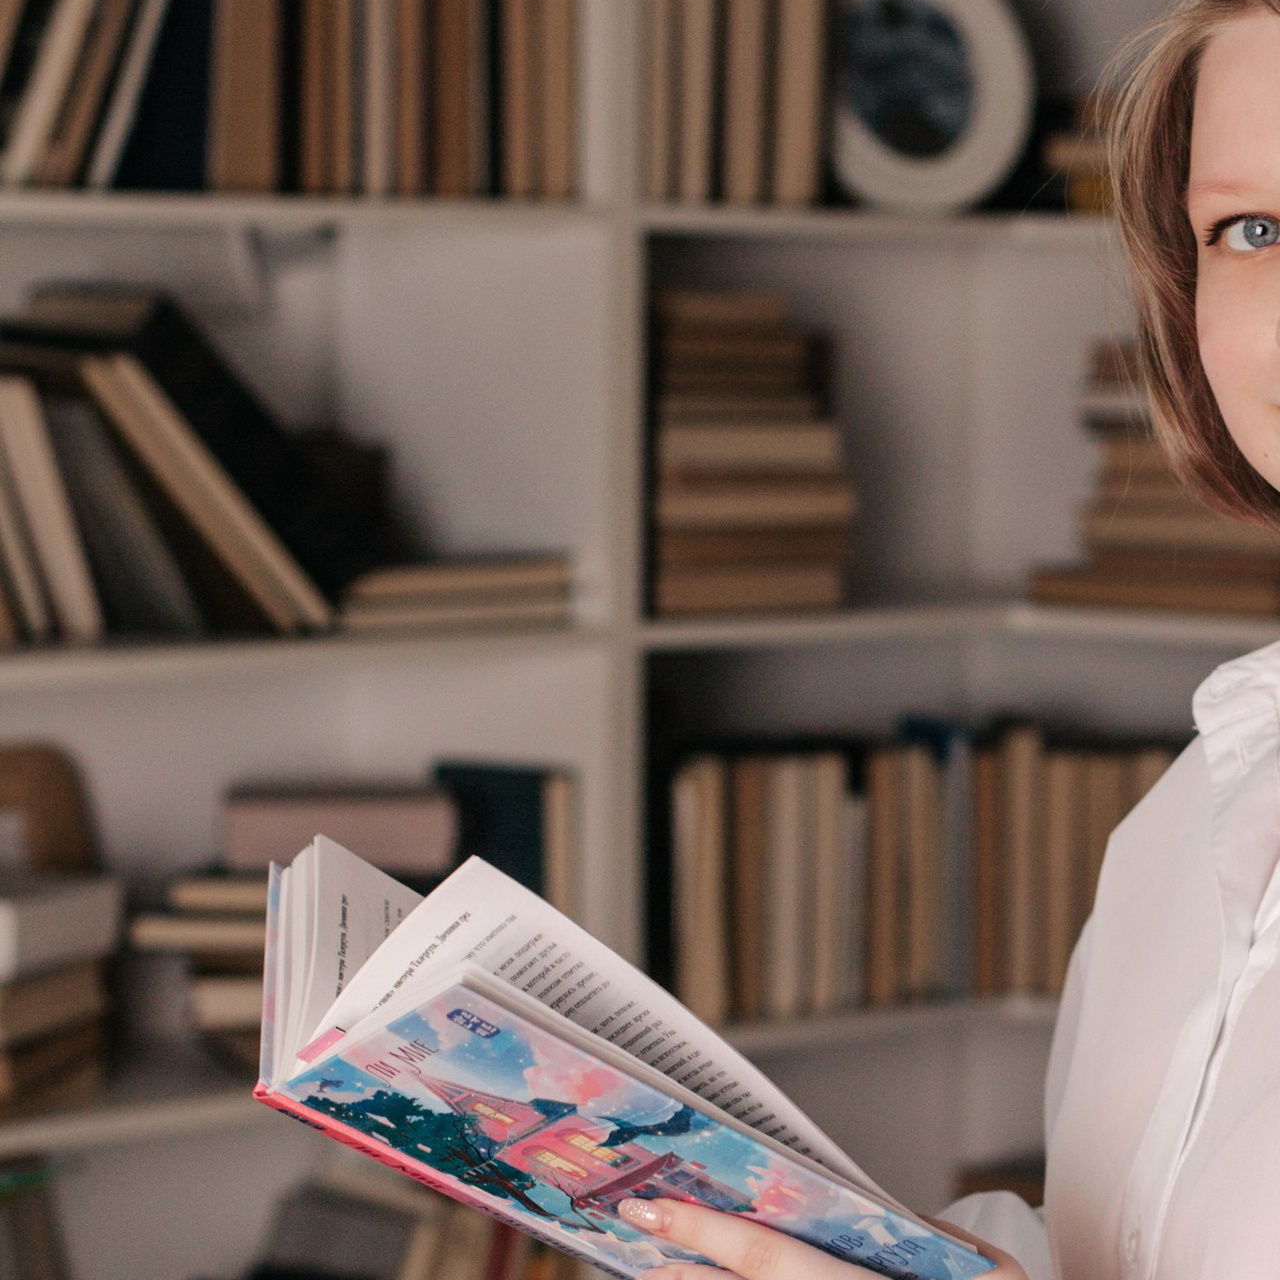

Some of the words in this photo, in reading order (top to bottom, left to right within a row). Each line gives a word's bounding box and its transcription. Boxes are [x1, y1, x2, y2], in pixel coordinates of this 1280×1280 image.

[499, 958, 514, 972] меня
[393, 968, 414, 990] мистера
[365, 1060, 401, 1089] ЛИ
[388, 1038, 440, 1076] МИЕ
[818, 1233, 866, 1258] НОВ»
[857, 1238, 928, 1271] ЕРГУТА
